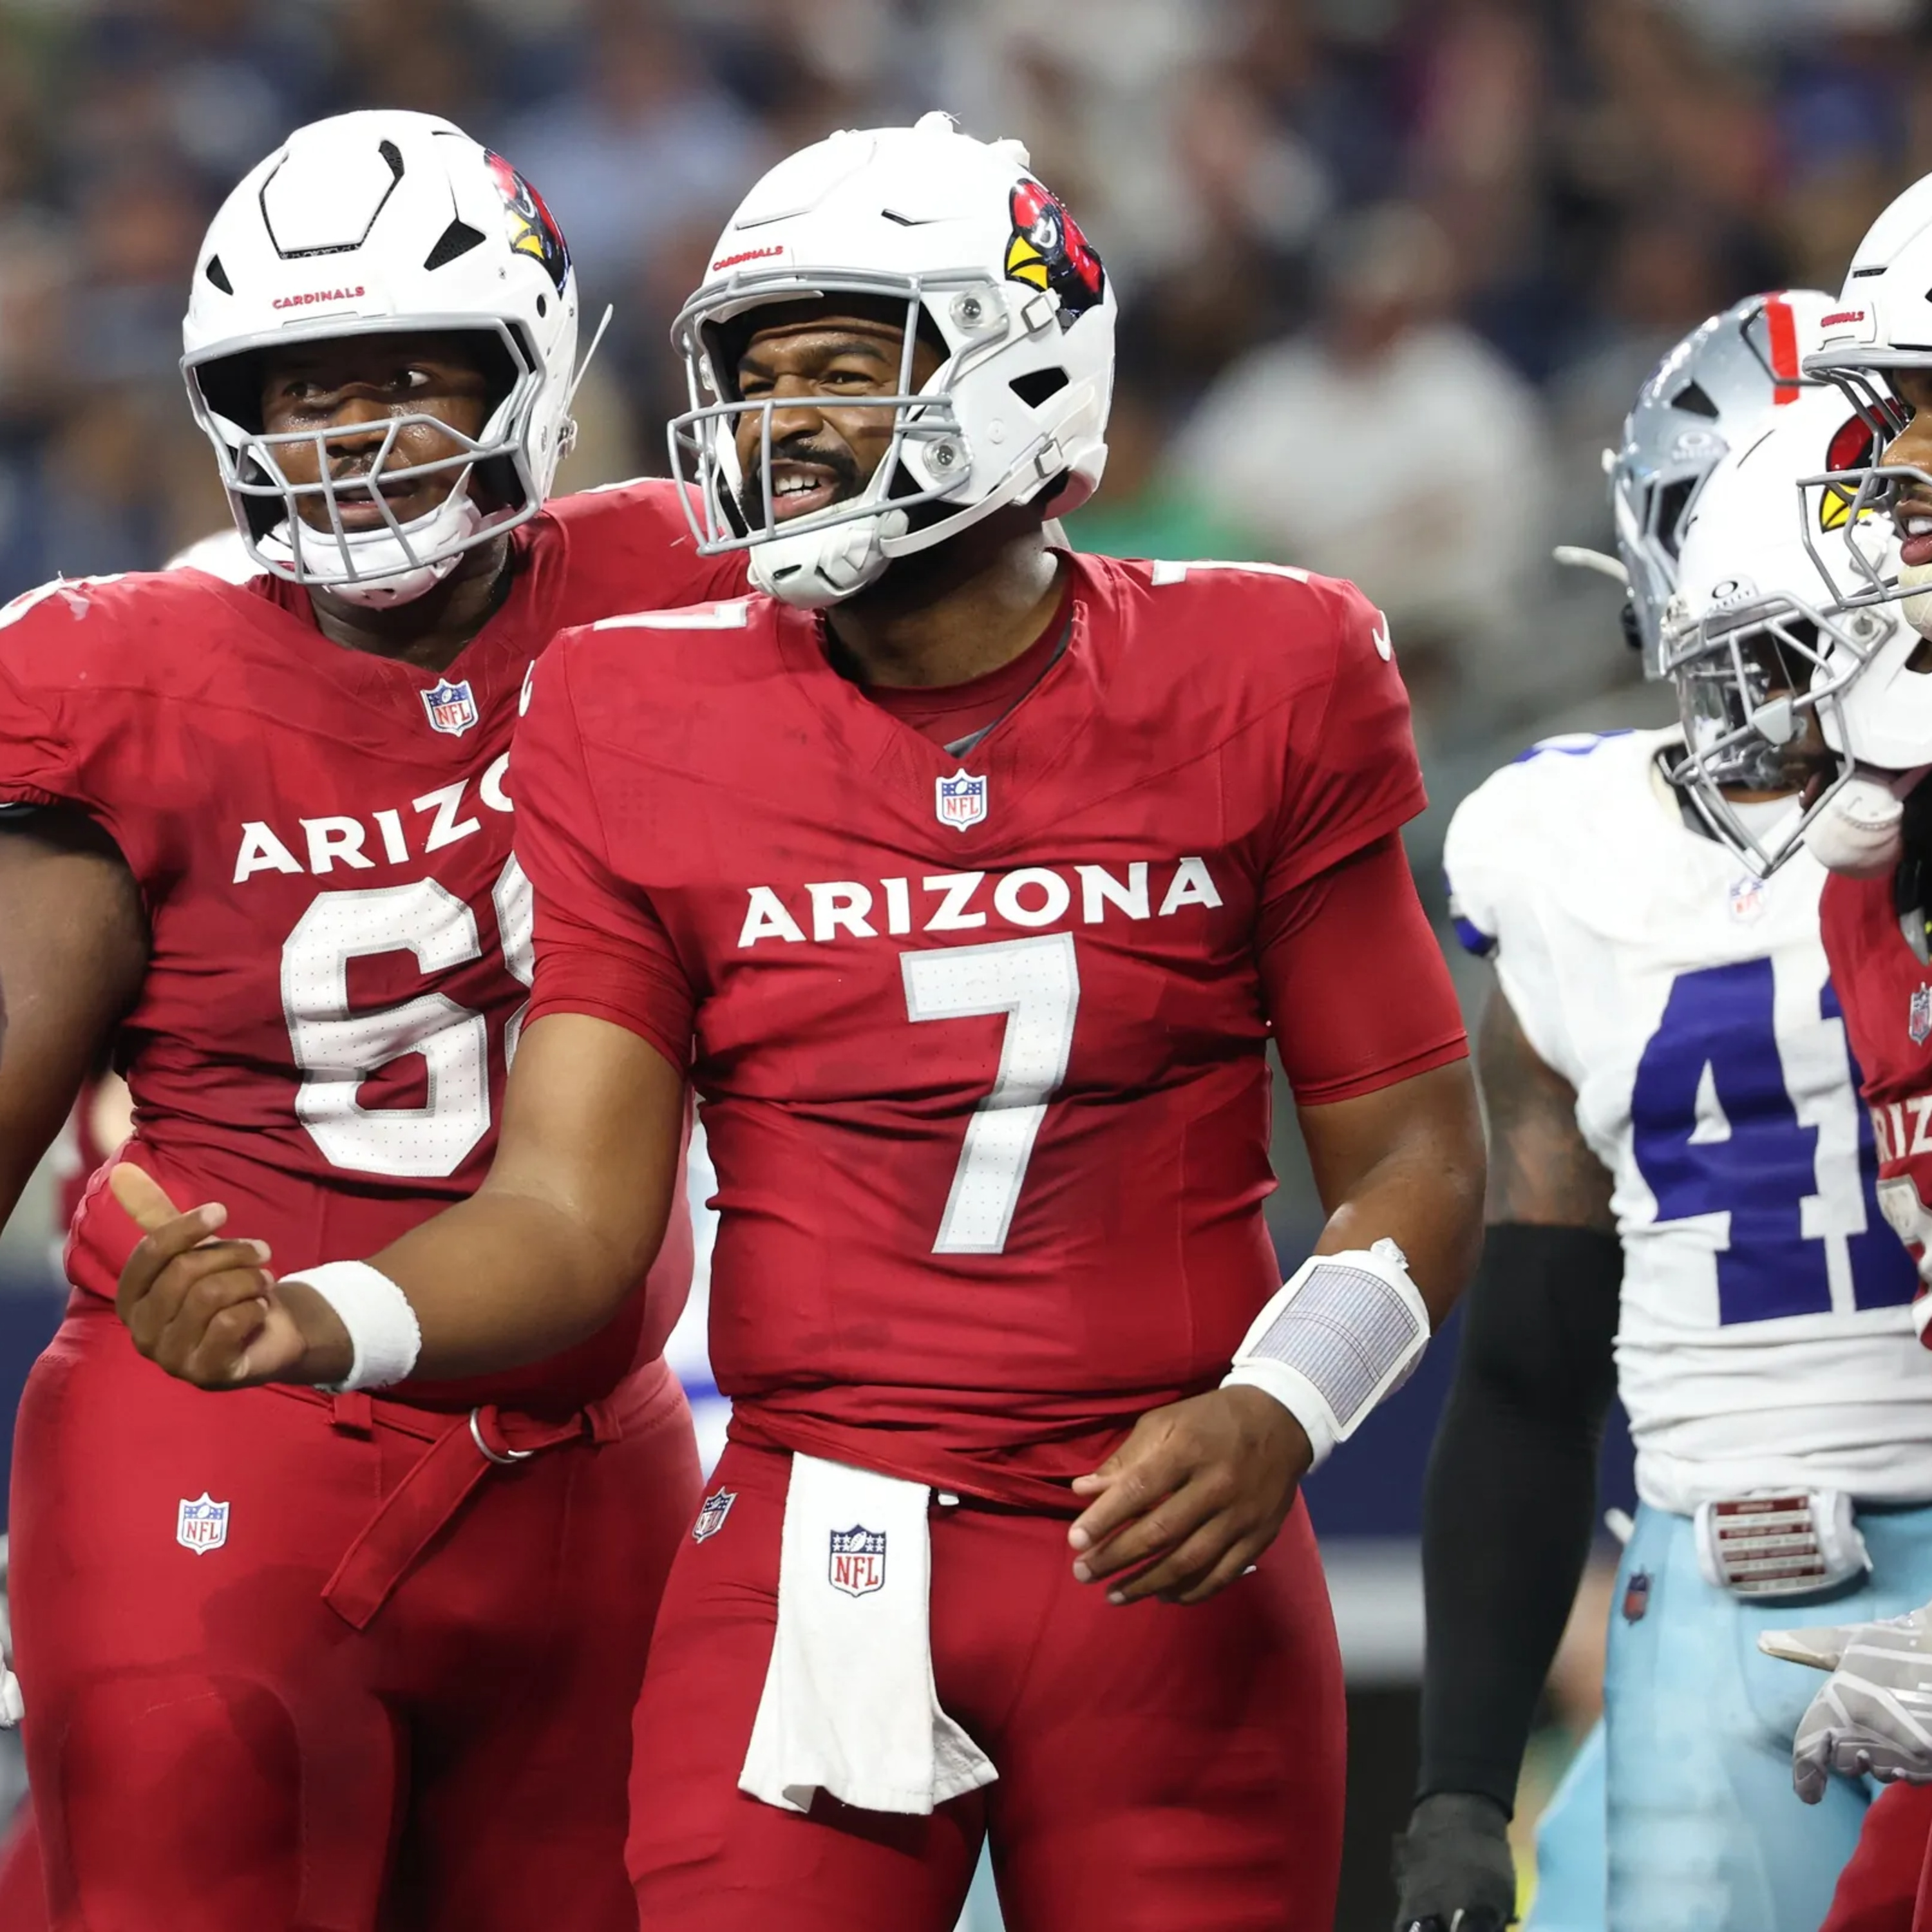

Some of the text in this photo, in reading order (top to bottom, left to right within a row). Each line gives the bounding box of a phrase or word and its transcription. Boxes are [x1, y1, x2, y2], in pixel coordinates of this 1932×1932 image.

[712, 245, 783, 271] CARDINALS
[272, 286, 365, 309] CARDINALS
[434, 702, 471, 726] NFL
[945, 796, 980, 819] NFL
[737, 857, 1224, 948] ARIZONA
[899, 931, 1081, 1254] 7
[186, 1520, 219, 1542] NFL
[835, 1555, 879, 1589] NFL
